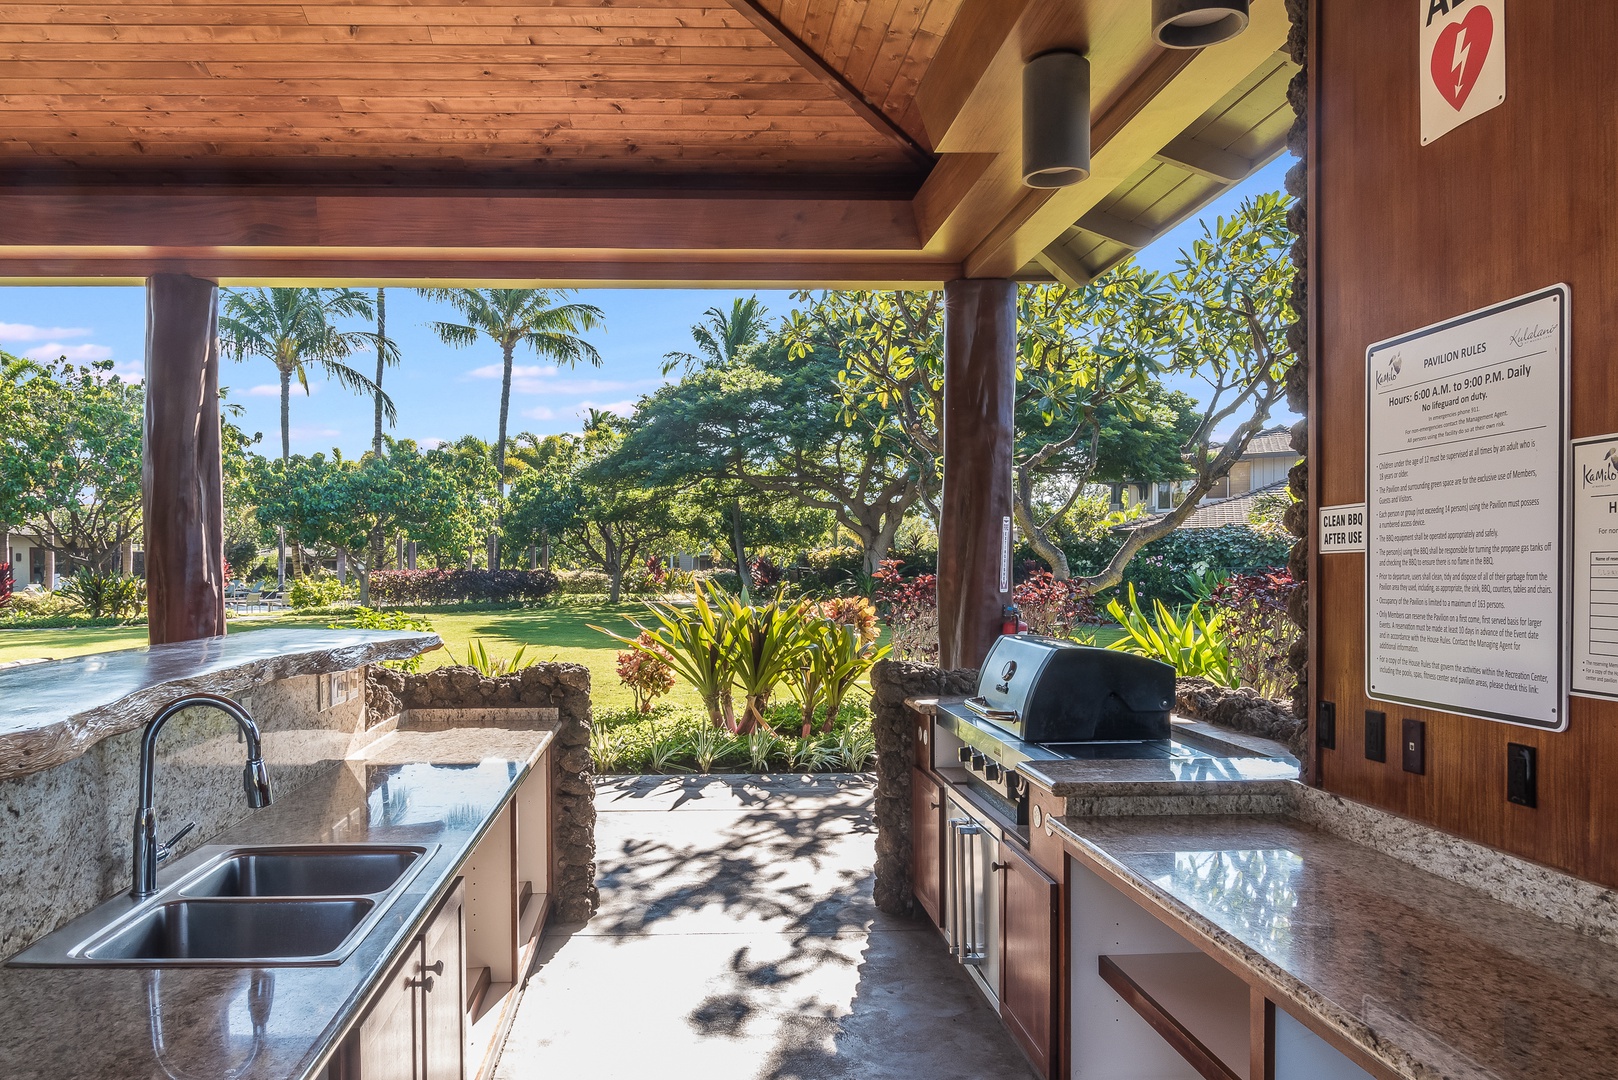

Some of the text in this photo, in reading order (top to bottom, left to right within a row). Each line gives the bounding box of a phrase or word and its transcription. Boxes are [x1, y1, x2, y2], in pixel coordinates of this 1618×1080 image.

[1424, 342, 1486, 368] PAVILION RULES
[1389, 364, 1531, 406] Hours: 6:00 A.M. to 9:00 P.M. Daily
[1432, 396, 1459, 409] lifeguard
[1471, 392, 1487, 401] duty.
[1433, 412, 1457, 420] emergencies
[1424, 455, 1429, 463] 12
[1446, 449, 1468, 461] supervised
[1493, 445, 1499, 454] by
[1506, 441, 1518, 451] adult
[1520, 440, 1530, 448] who
[1531, 439, 1536, 447] is
[1430, 481, 1442, 490] green
[1442, 480, 1454, 488] space
[1477, 474, 1497, 482] exclusive
[1506, 470, 1512, 479] of
[1425, 506, 1444, 515] exceeding
[1451, 503, 1468, 513] persons)
[1469, 503, 1480, 512] using
[1489, 500, 1507, 509] Pavilion
[1520, 499, 1539, 508] possess
[1324, 513, 1363, 527] CLEAN BBQ
[1324, 531, 1362, 544] AFTER USE
[1429, 532, 1447, 541] operated
[1448, 530, 1475, 540] appropriately
[1476, 529, 1484, 538] and
[1420, 547, 1428, 555] BBQ
[1439, 546, 1444, 554] be
[1444, 546, 1468, 555] responsible
[1475, 545, 1491, 554] turning
[1492, 544, 1500, 552] the
[1501, 546, 1520, 554] propane
[1521, 545, 1529, 554] gas
[1530, 543, 1543, 551] tanks
[1428, 598, 1442, 606] limited
[1472, 599, 1477, 608] of
[1478, 600, 1486, 608] 163
